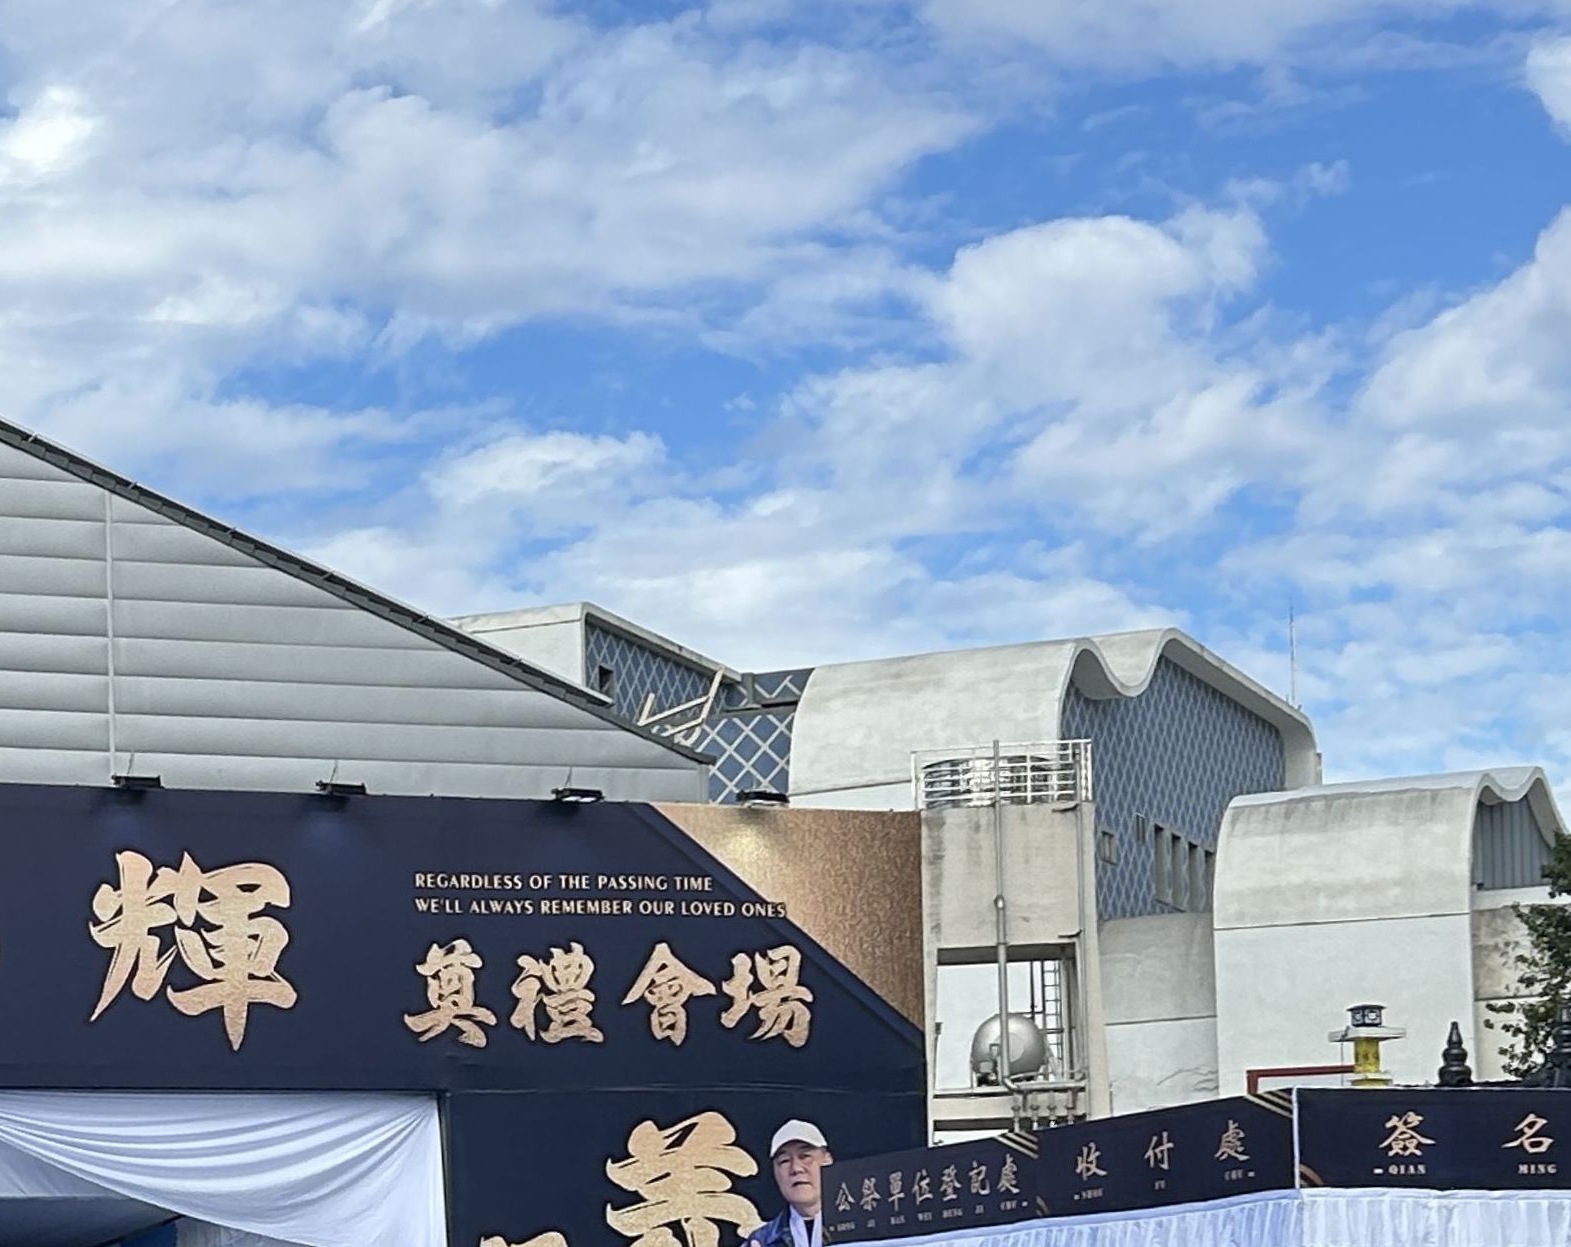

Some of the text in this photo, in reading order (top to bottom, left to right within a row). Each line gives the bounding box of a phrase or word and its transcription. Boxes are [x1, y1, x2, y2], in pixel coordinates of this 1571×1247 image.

[414, 872, 714, 892] REGARDLESS OF THE PASSING TIME
[414, 897, 788, 919] WE'LL ALWAYS REMEMBER OUR LOVED ONES
[404, 937, 814, 1048] 奠禮會場
[1074, 1119, 1251, 1182] 收付處
[1378, 1110, 1555, 1157] 簽名
[834, 1153, 1021, 1213] 公祭單位登記處
[1387, 1163, 1558, 1176] QIAN MING
